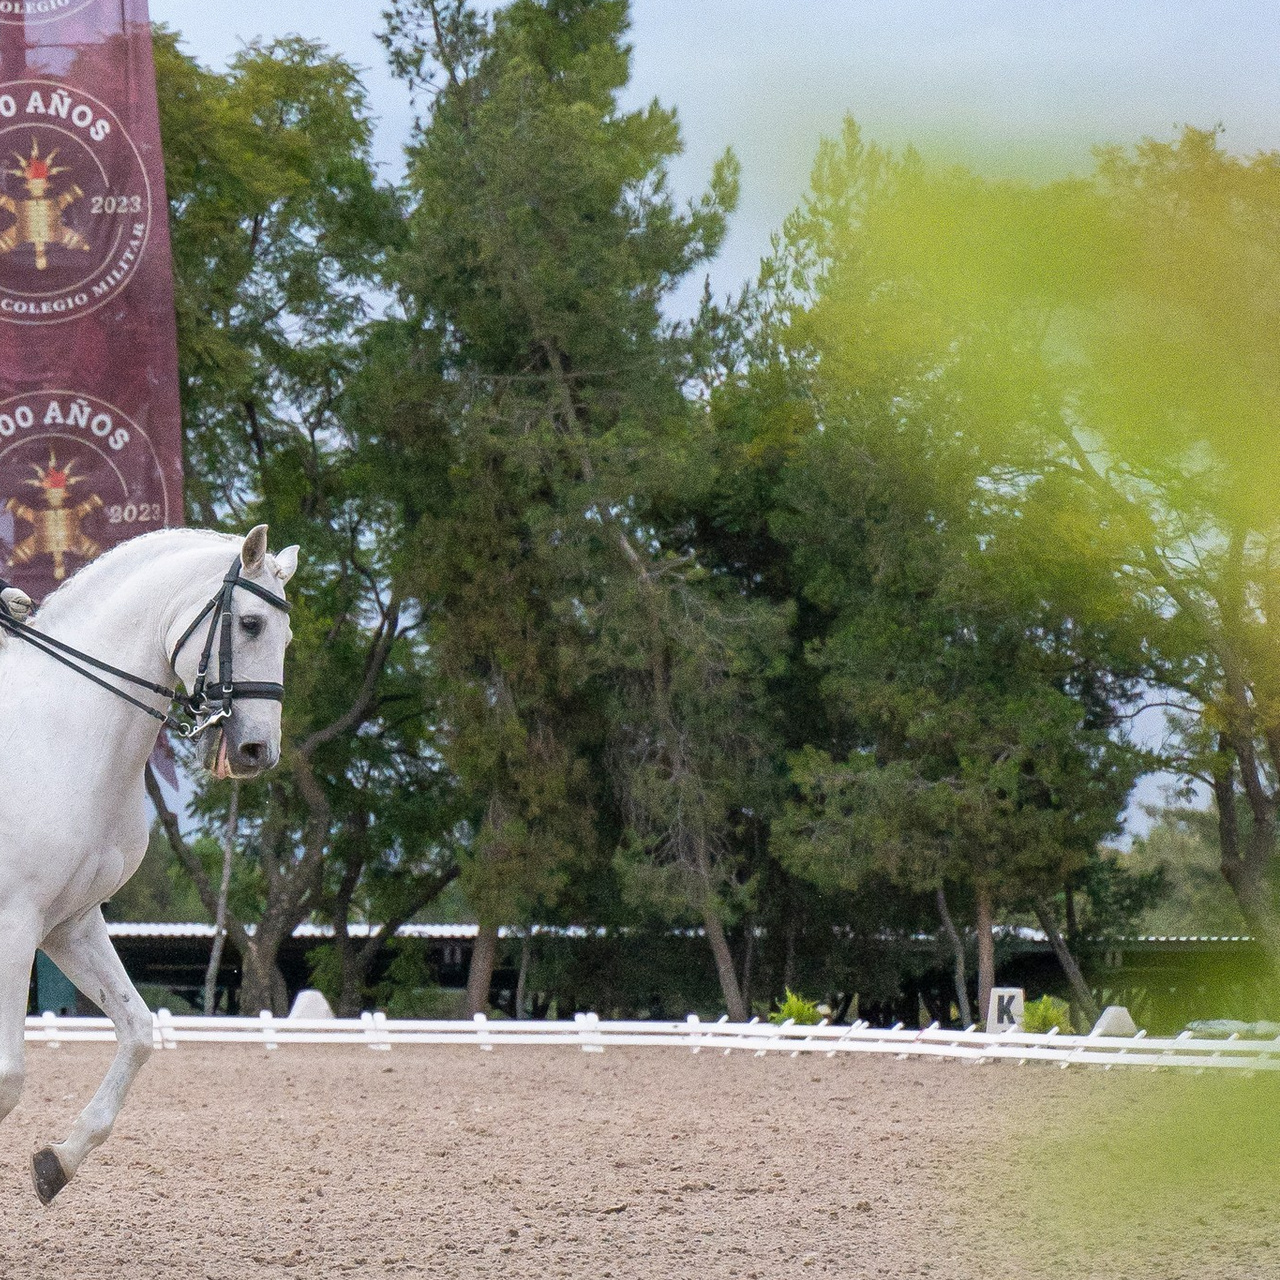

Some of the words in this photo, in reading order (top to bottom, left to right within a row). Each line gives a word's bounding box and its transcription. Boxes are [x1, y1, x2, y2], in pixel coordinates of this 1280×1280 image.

[26, 89, 111, 142] AÑOS
[91, 195, 142, 215] 2023
[1, 293, 88, 314] COLEGIO
[91, 222, 145, 297] MILITAR
[43, 399, 130, 451] AÑOS
[108, 503, 161, 523] 2023
[997, 995, 1016, 1024] K
